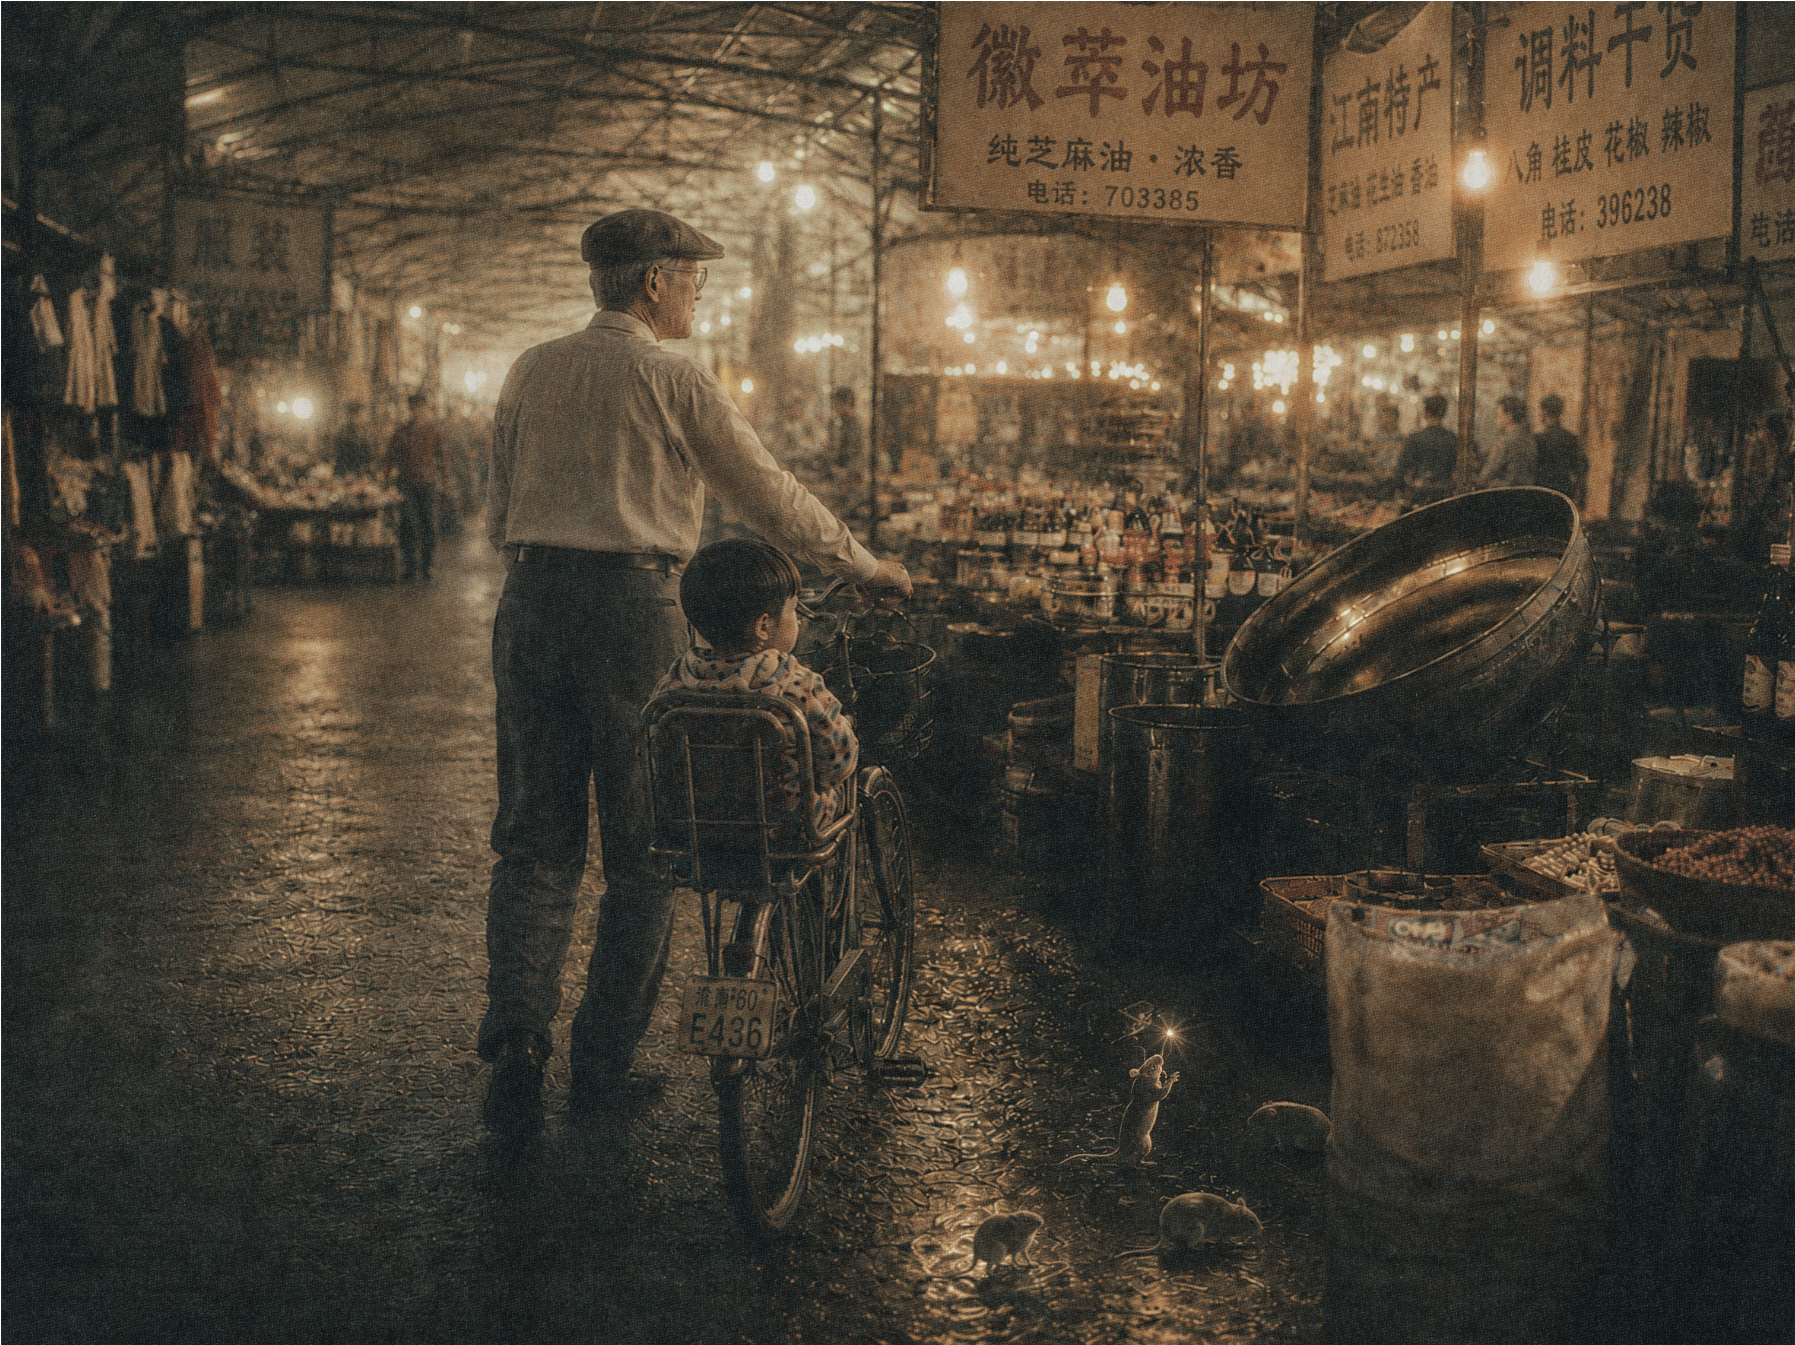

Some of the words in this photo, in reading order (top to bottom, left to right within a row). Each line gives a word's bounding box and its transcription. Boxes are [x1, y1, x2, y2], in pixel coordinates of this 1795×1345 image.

[967, 23, 1288, 125] 徽萃油坊
[1330, 52, 1440, 156] 江南特产
[1506, 140, 1543, 184] 八角
[1551, 129, 1594, 178] 桂皮
[1604, 116, 1649, 167] 花椒
[1661, 101, 1712, 154] 辣椒
[1105, 185, 1199, 211] 703385
[1597, 183, 1672, 229] 396238
[690, 1012, 762, 1050] E436
